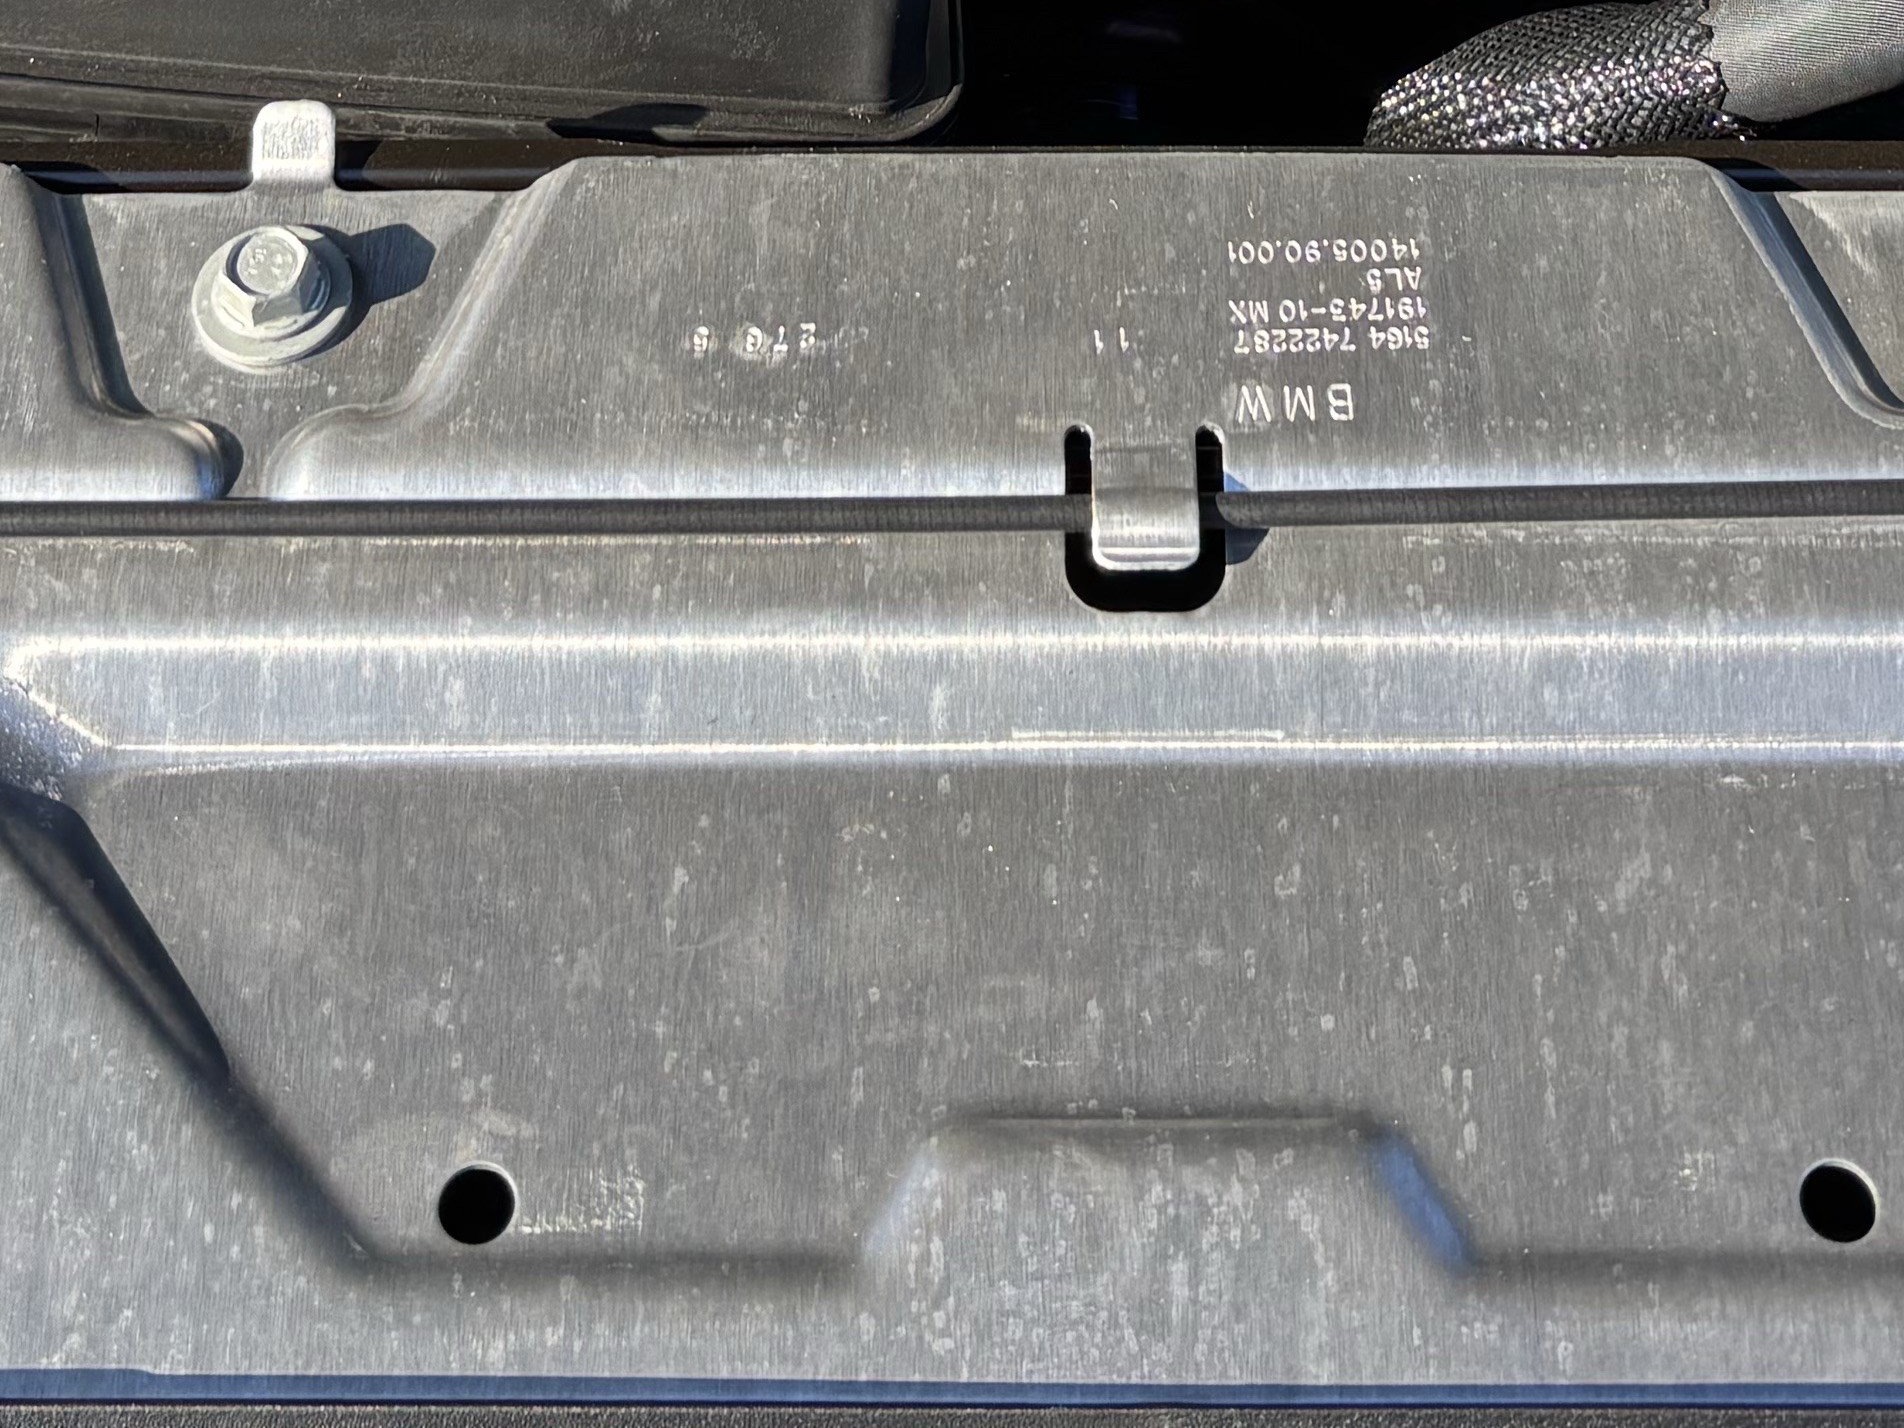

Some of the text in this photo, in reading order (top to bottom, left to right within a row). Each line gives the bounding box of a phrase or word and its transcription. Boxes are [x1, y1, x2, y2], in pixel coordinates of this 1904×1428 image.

[1227, 237, 1421, 265] 14005.90.001
[1228, 298, 1269, 325] MX
[1232, 325, 1430, 355] 5164 7422287
[1237, 382, 1355, 423] BMW
